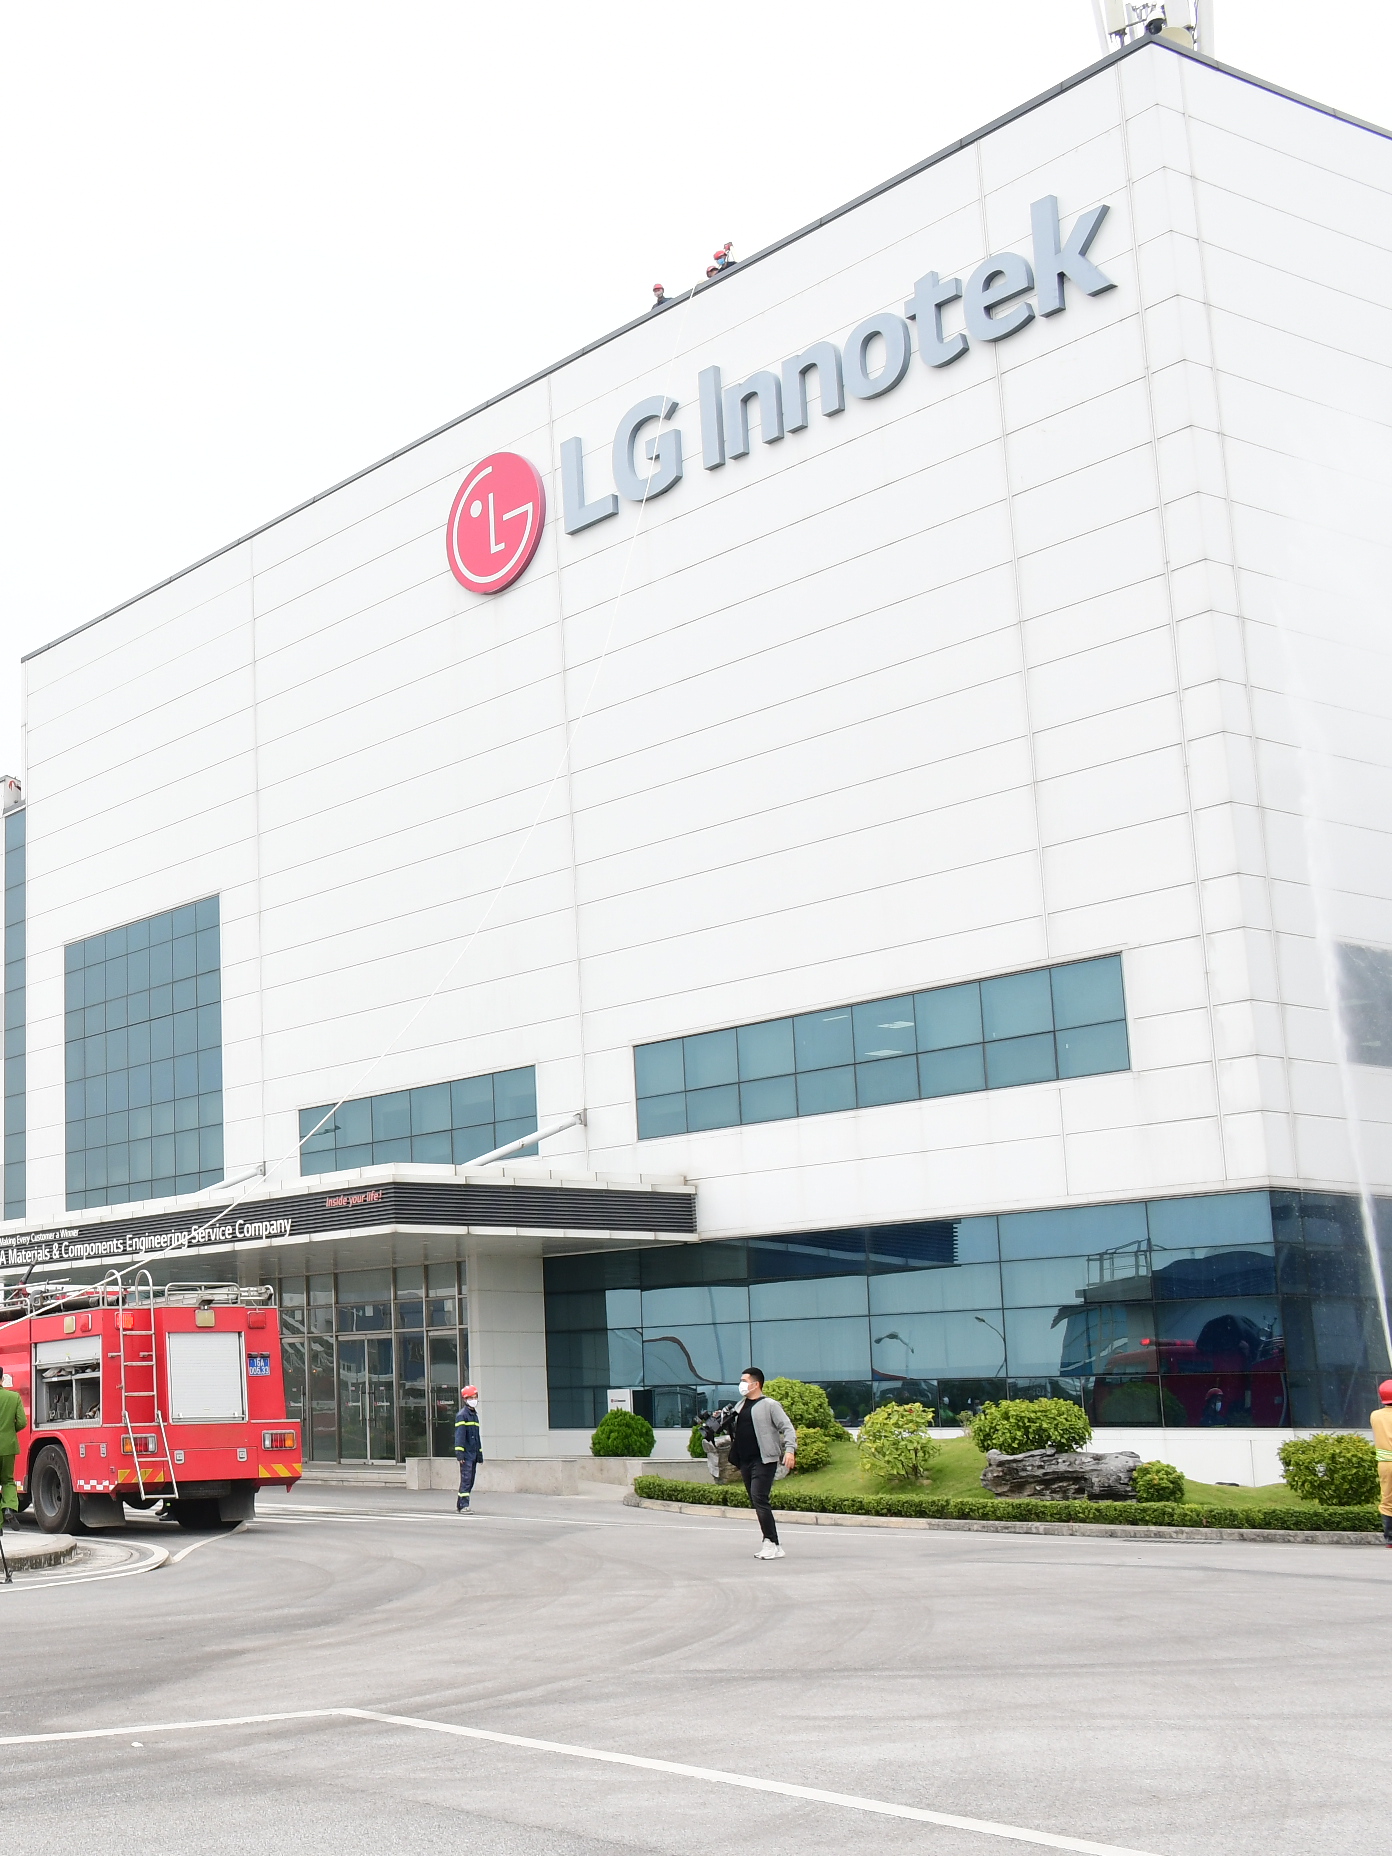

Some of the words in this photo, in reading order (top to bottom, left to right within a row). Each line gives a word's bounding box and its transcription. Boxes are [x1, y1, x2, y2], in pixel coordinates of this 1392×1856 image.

[559, 395, 683, 536] LG
[698, 194, 1119, 471] Innotek
[326, 1195, 347, 1207] Inside
[349, 1194, 365, 1207] your
[367, 1190, 382, 1201] life!
[0, 1237, 16, 1247] Making
[17, 1235, 30, 1245] Every
[31, 1232, 55, 1242] Customer
[56, 1231, 59, 1239] a
[60, 1229, 79, 1238] Winner
[0, 1250, 6, 1266] A
[8, 1244, 50, 1264] Materials
[53, 1243, 59, 1259] &
[62, 1238, 123, 1260] Components
[126, 1230, 189, 1254] Engineering
[192, 1223, 232, 1243] Service
[236, 1219, 292, 1239] Company
